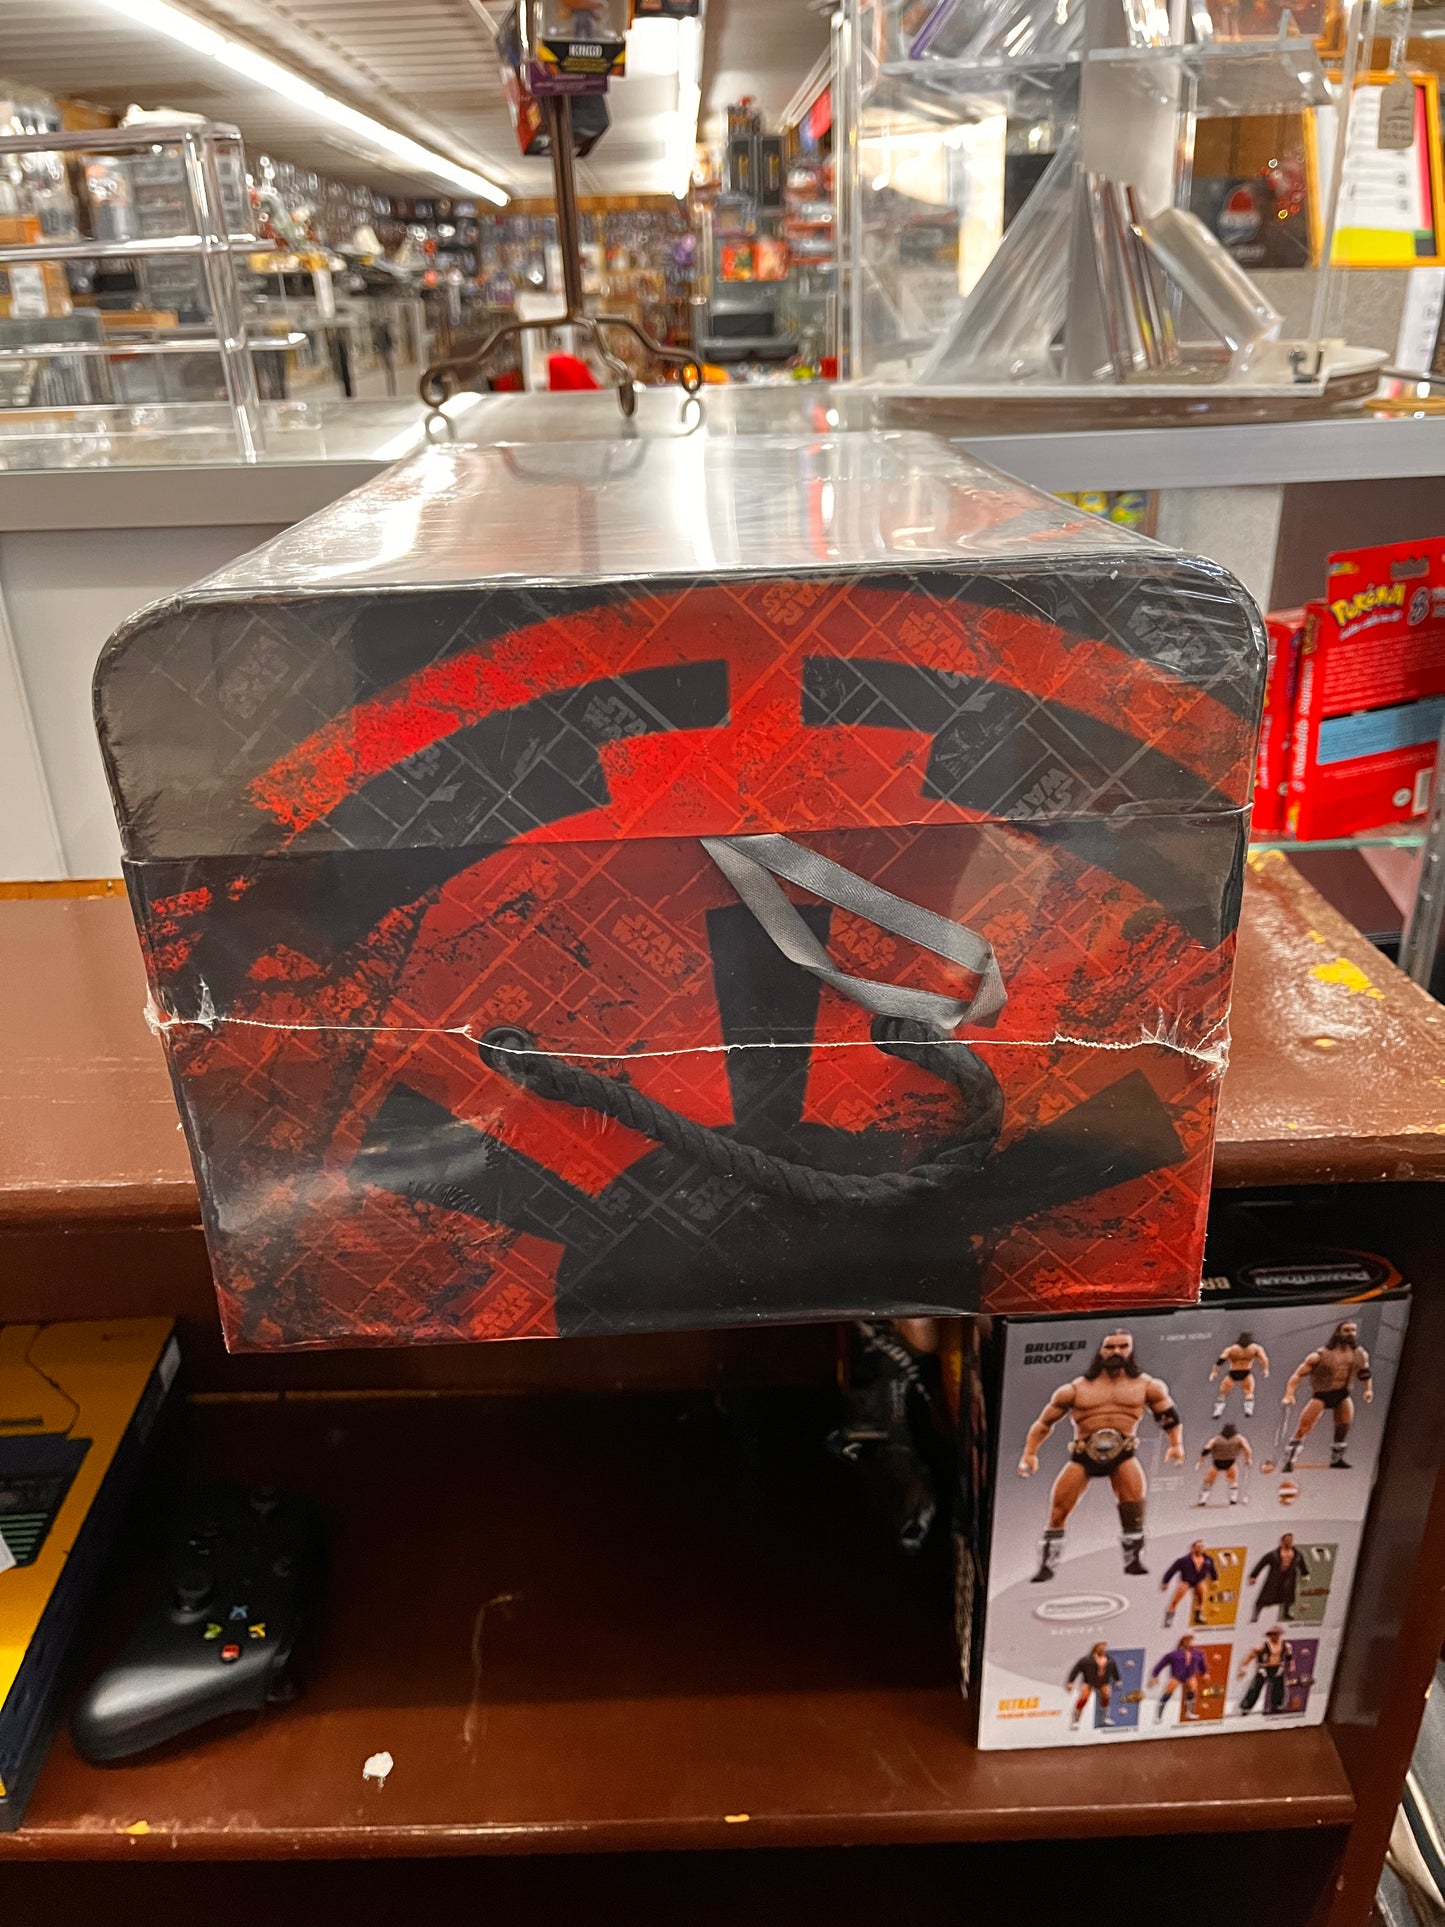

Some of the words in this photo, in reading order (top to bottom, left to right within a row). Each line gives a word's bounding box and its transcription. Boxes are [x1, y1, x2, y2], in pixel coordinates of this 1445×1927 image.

[895, 619, 971, 690] WARS
[907, 609, 978, 676] STAR
[615, 920, 683, 978] WARS
[620, 914, 687, 965] STAR
[468, 1282, 525, 1335] WARS
[475, 1291, 532, 1338] STAR
[1023, 1353, 1073, 1365] BRODY
[1025, 1340, 1087, 1354] BRUISER
